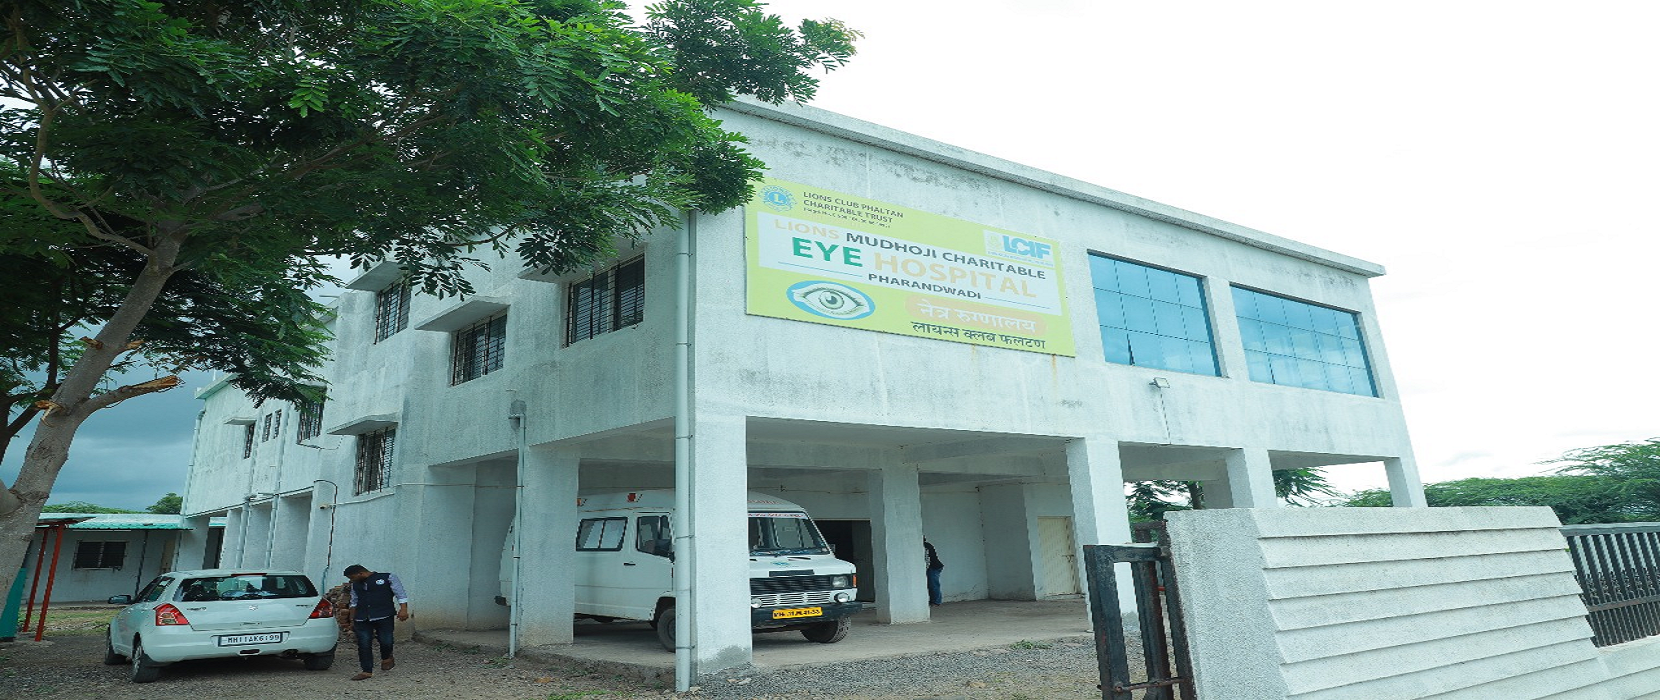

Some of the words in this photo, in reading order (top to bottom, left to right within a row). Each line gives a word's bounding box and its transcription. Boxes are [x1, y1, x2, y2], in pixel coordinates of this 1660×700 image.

[803, 191, 832, 202] LIONS
[835, 198, 860, 208] CLUB
[861, 204, 904, 218] PHALTAN
[803, 199, 863, 217] CHARITABLE
[865, 211, 893, 223] TRUST
[774, 219, 840, 239] LIONS
[846, 232, 937, 259] MUDHOJI
[942, 252, 1047, 280] CHARITABLE
[1002, 234, 1052, 260] LCIF
[792, 236, 863, 267] EYE
[874, 252, 1037, 298] HOSPITAL
[868, 273, 982, 299] PHARANDWADI
[916, 298, 949, 320] नेत्र
[954, 308, 1037, 333] रुग्णालय
[910, 321, 960, 338] लायन्स
[962, 328, 997, 343] क्लब
[999, 333, 1046, 350] फलटण
